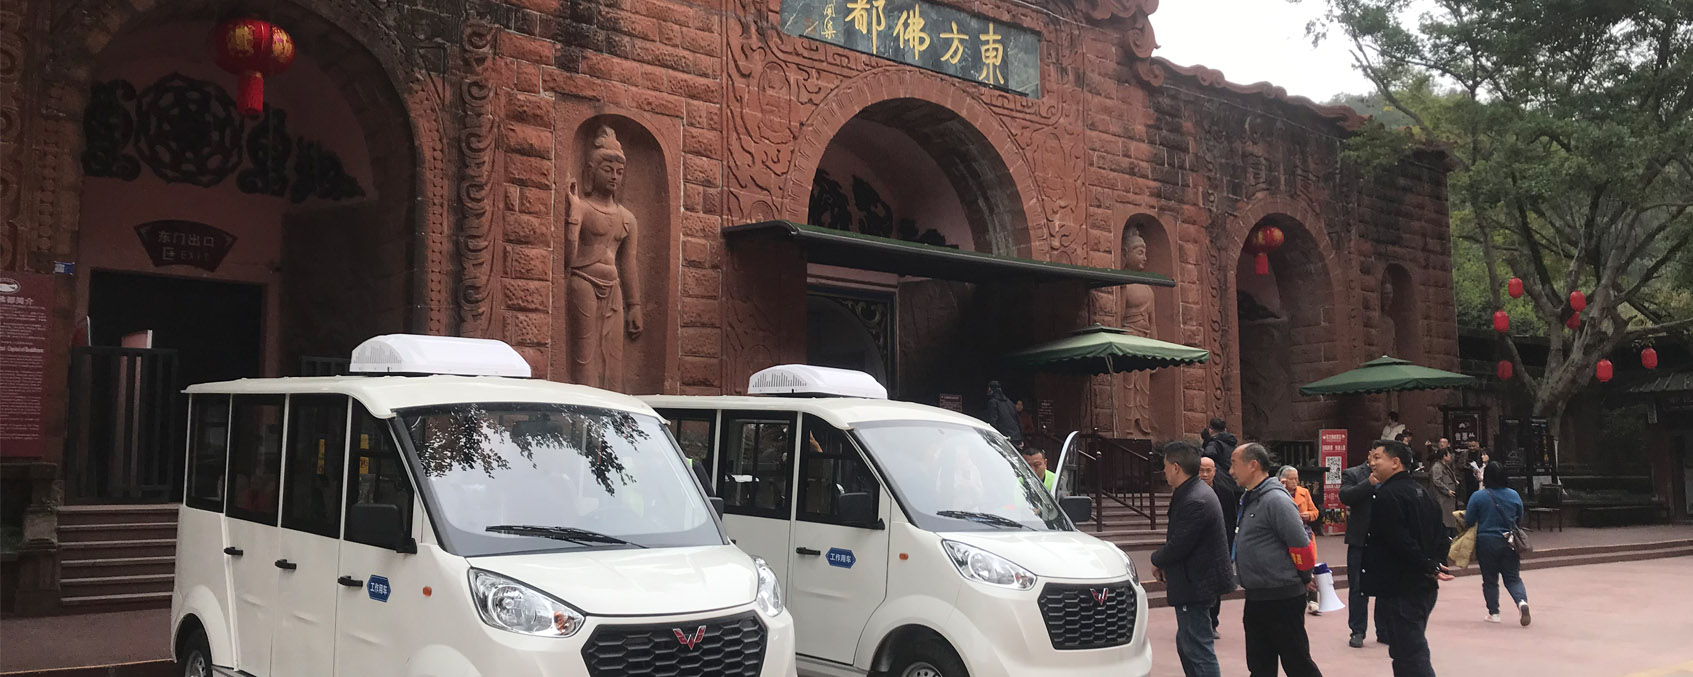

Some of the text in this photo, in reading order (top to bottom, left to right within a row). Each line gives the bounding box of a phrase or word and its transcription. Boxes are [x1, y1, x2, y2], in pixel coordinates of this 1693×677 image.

[158, 230, 215, 248] 东门出口
[830, 553, 851, 563] 工作用车
[370, 583, 387, 594] 工作用车
